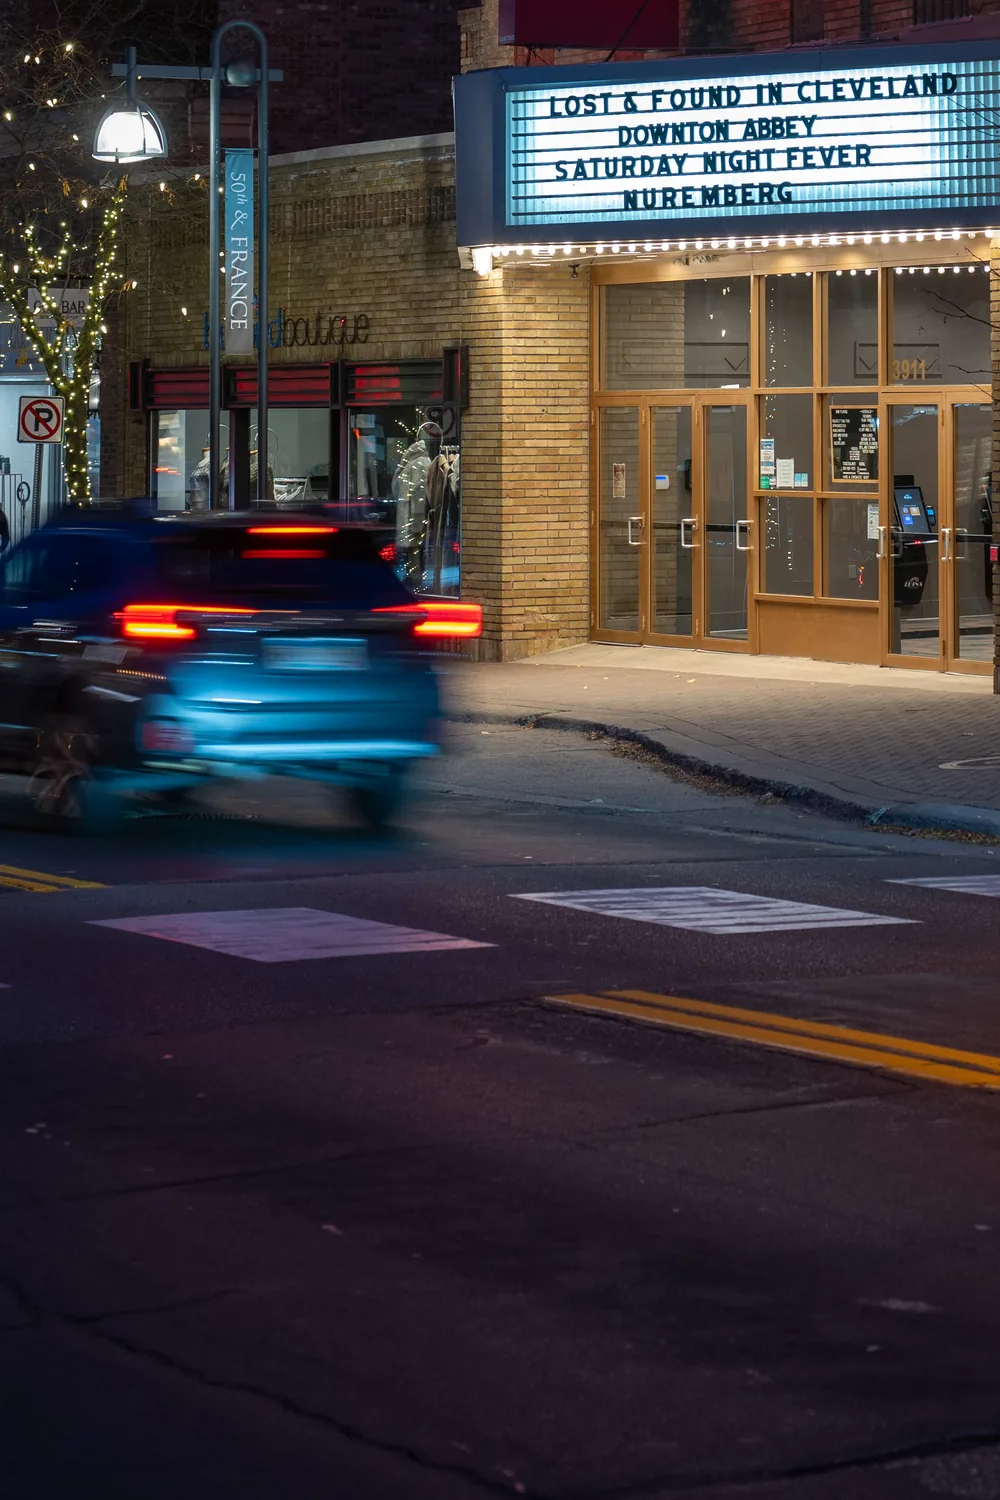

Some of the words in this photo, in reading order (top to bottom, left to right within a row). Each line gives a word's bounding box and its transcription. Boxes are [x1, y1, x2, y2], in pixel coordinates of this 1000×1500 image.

[550, 92, 613, 117] LOST
[622, 90, 639, 113] &
[652, 85, 741, 109] FOUND
[756, 82, 783, 104] IN
[797, 72, 958, 102] CLEVELAND
[618, 119, 730, 147] DOWNTON
[742, 115, 818, 140] ABBEY
[555, 152, 688, 181] SATURDAY
[703, 149, 776, 173] NIGHT
[786, 144, 872, 168] FEVER
[230, 172, 248, 205] 50th
[623, 182, 793, 210] NUREMBERG
[230, 209, 249, 231] &
[230, 236, 248, 330] FRANCE
[61, 300, 86, 314] BAR
[892, 359, 926, 380] 3911
